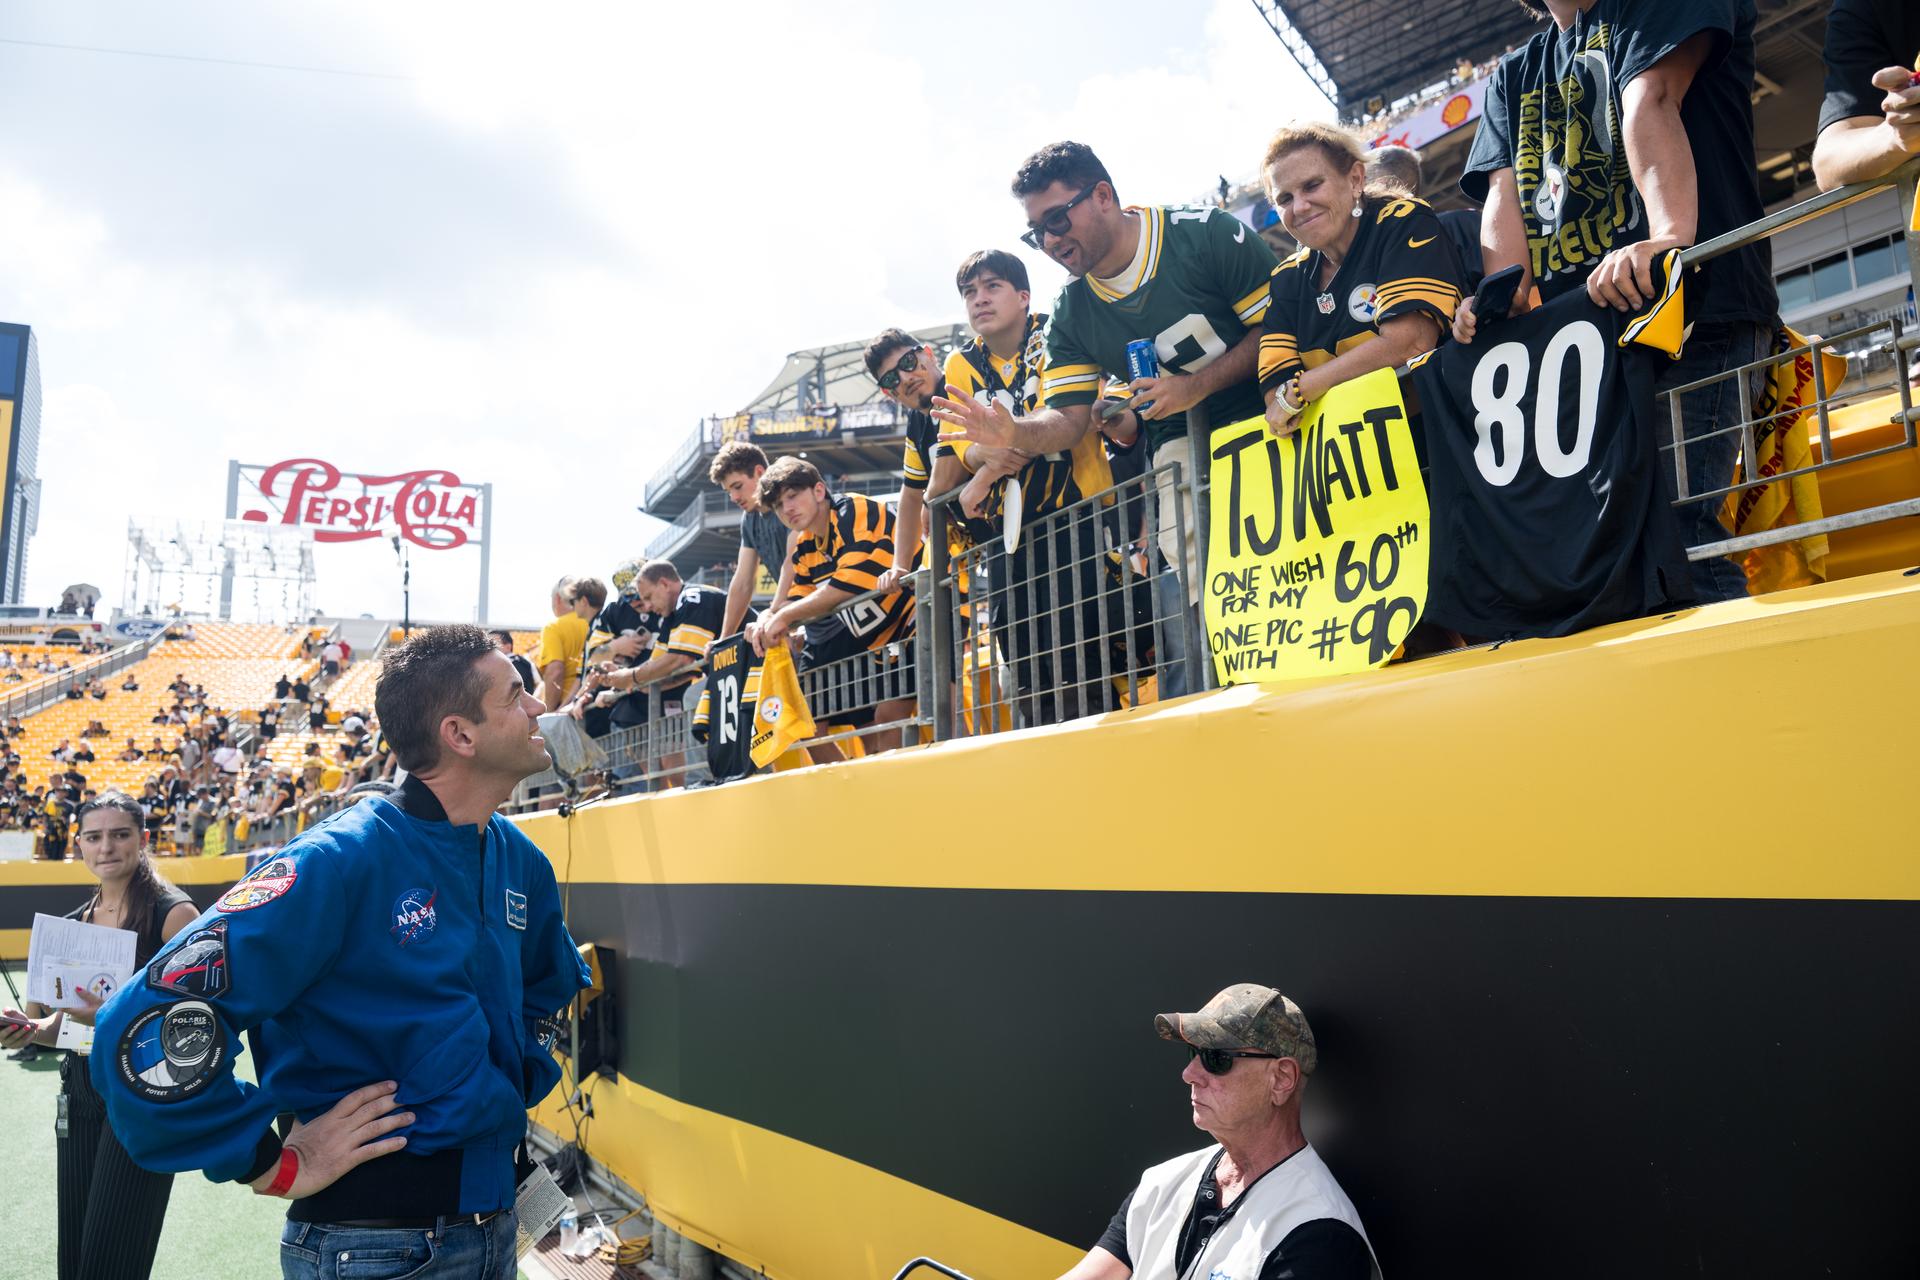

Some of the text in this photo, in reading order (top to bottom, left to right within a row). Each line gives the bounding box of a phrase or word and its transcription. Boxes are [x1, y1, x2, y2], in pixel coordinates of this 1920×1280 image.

[1471, 320, 1605, 487] 80
[1212, 404, 1404, 558] TJ WATT
[1212, 553, 1325, 597] ONE WISH
[1221, 585, 1308, 618] FOR MY
[1212, 619, 1304, 656] ONE PIC
[1223, 649, 1278, 677] WITH
[717, 674, 739, 745] 13
[396, 906, 436, 926] NASA
[172, 1016, 207, 1025] POLARIS
[121, 1054, 136, 1082] ISAACMAN
[210, 1047, 222, 1068] MENON
[145, 1087, 168, 1097] POTEET
[184, 1079, 202, 1092] GILLIS
